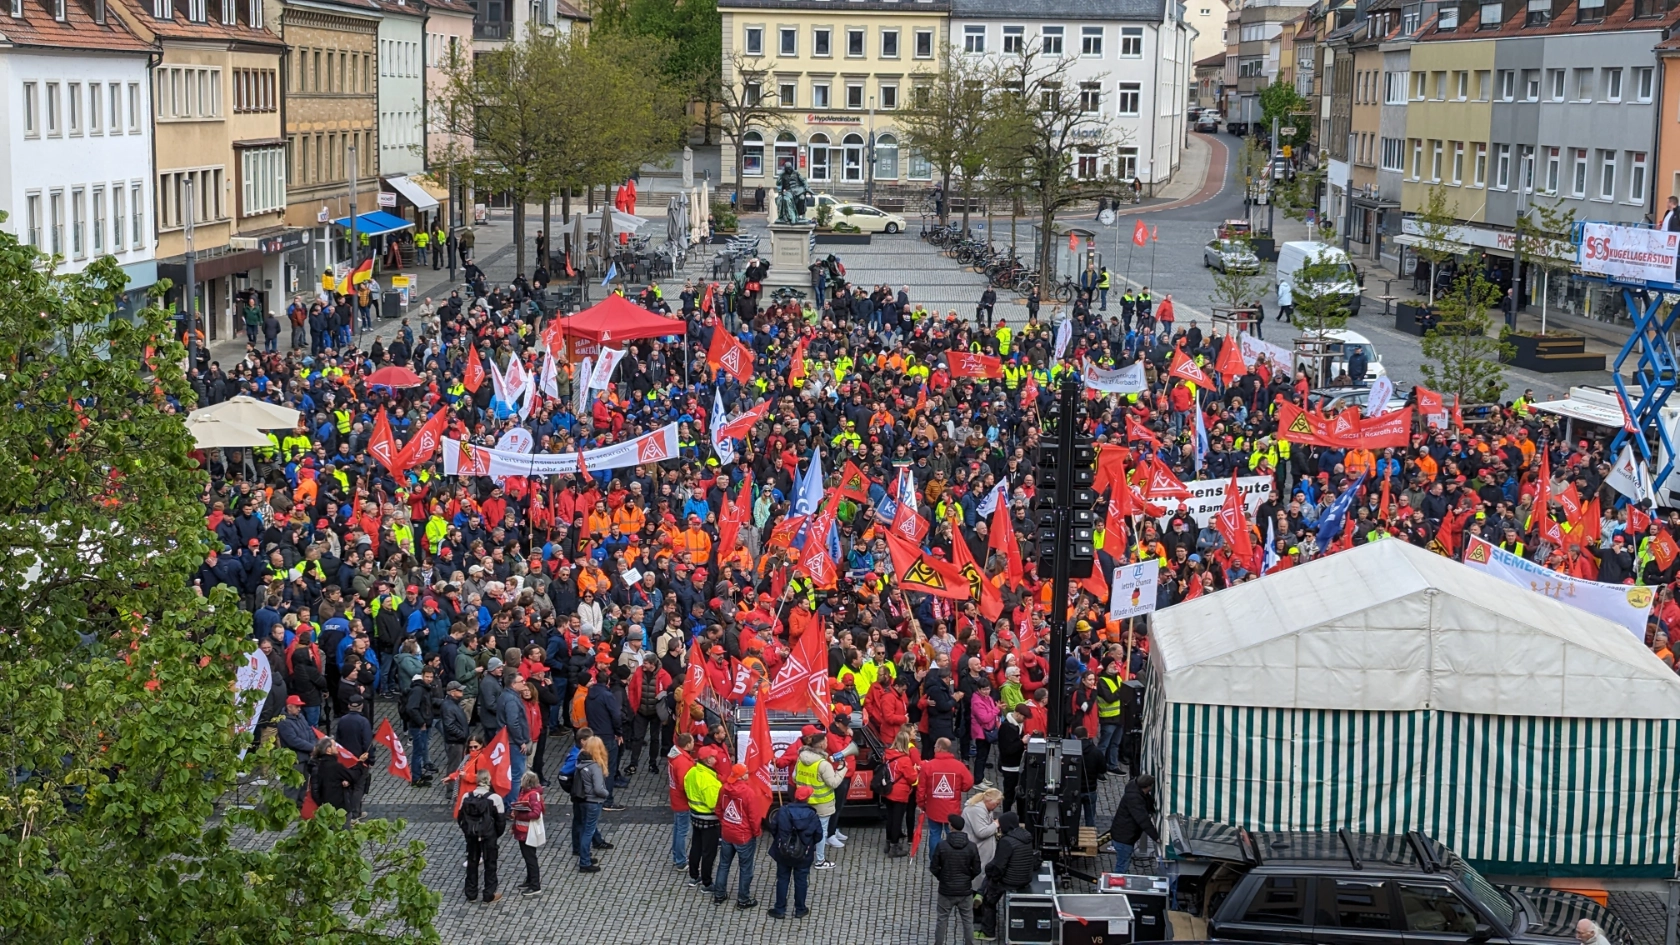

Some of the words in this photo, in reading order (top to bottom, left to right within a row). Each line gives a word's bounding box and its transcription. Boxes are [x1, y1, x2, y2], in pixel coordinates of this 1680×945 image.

[815, 114, 861, 122] HypoVereinsbank
[1585, 236, 1610, 261] SOS
[1609, 249, 1674, 265] KUGELLAGERSTADT
[1392, 427, 1404, 435] AG
[1199, 502, 1250, 514] Bamg
[1492, 549, 1554, 578] SIEMENS
[1091, 936, 1104, 944] V8
